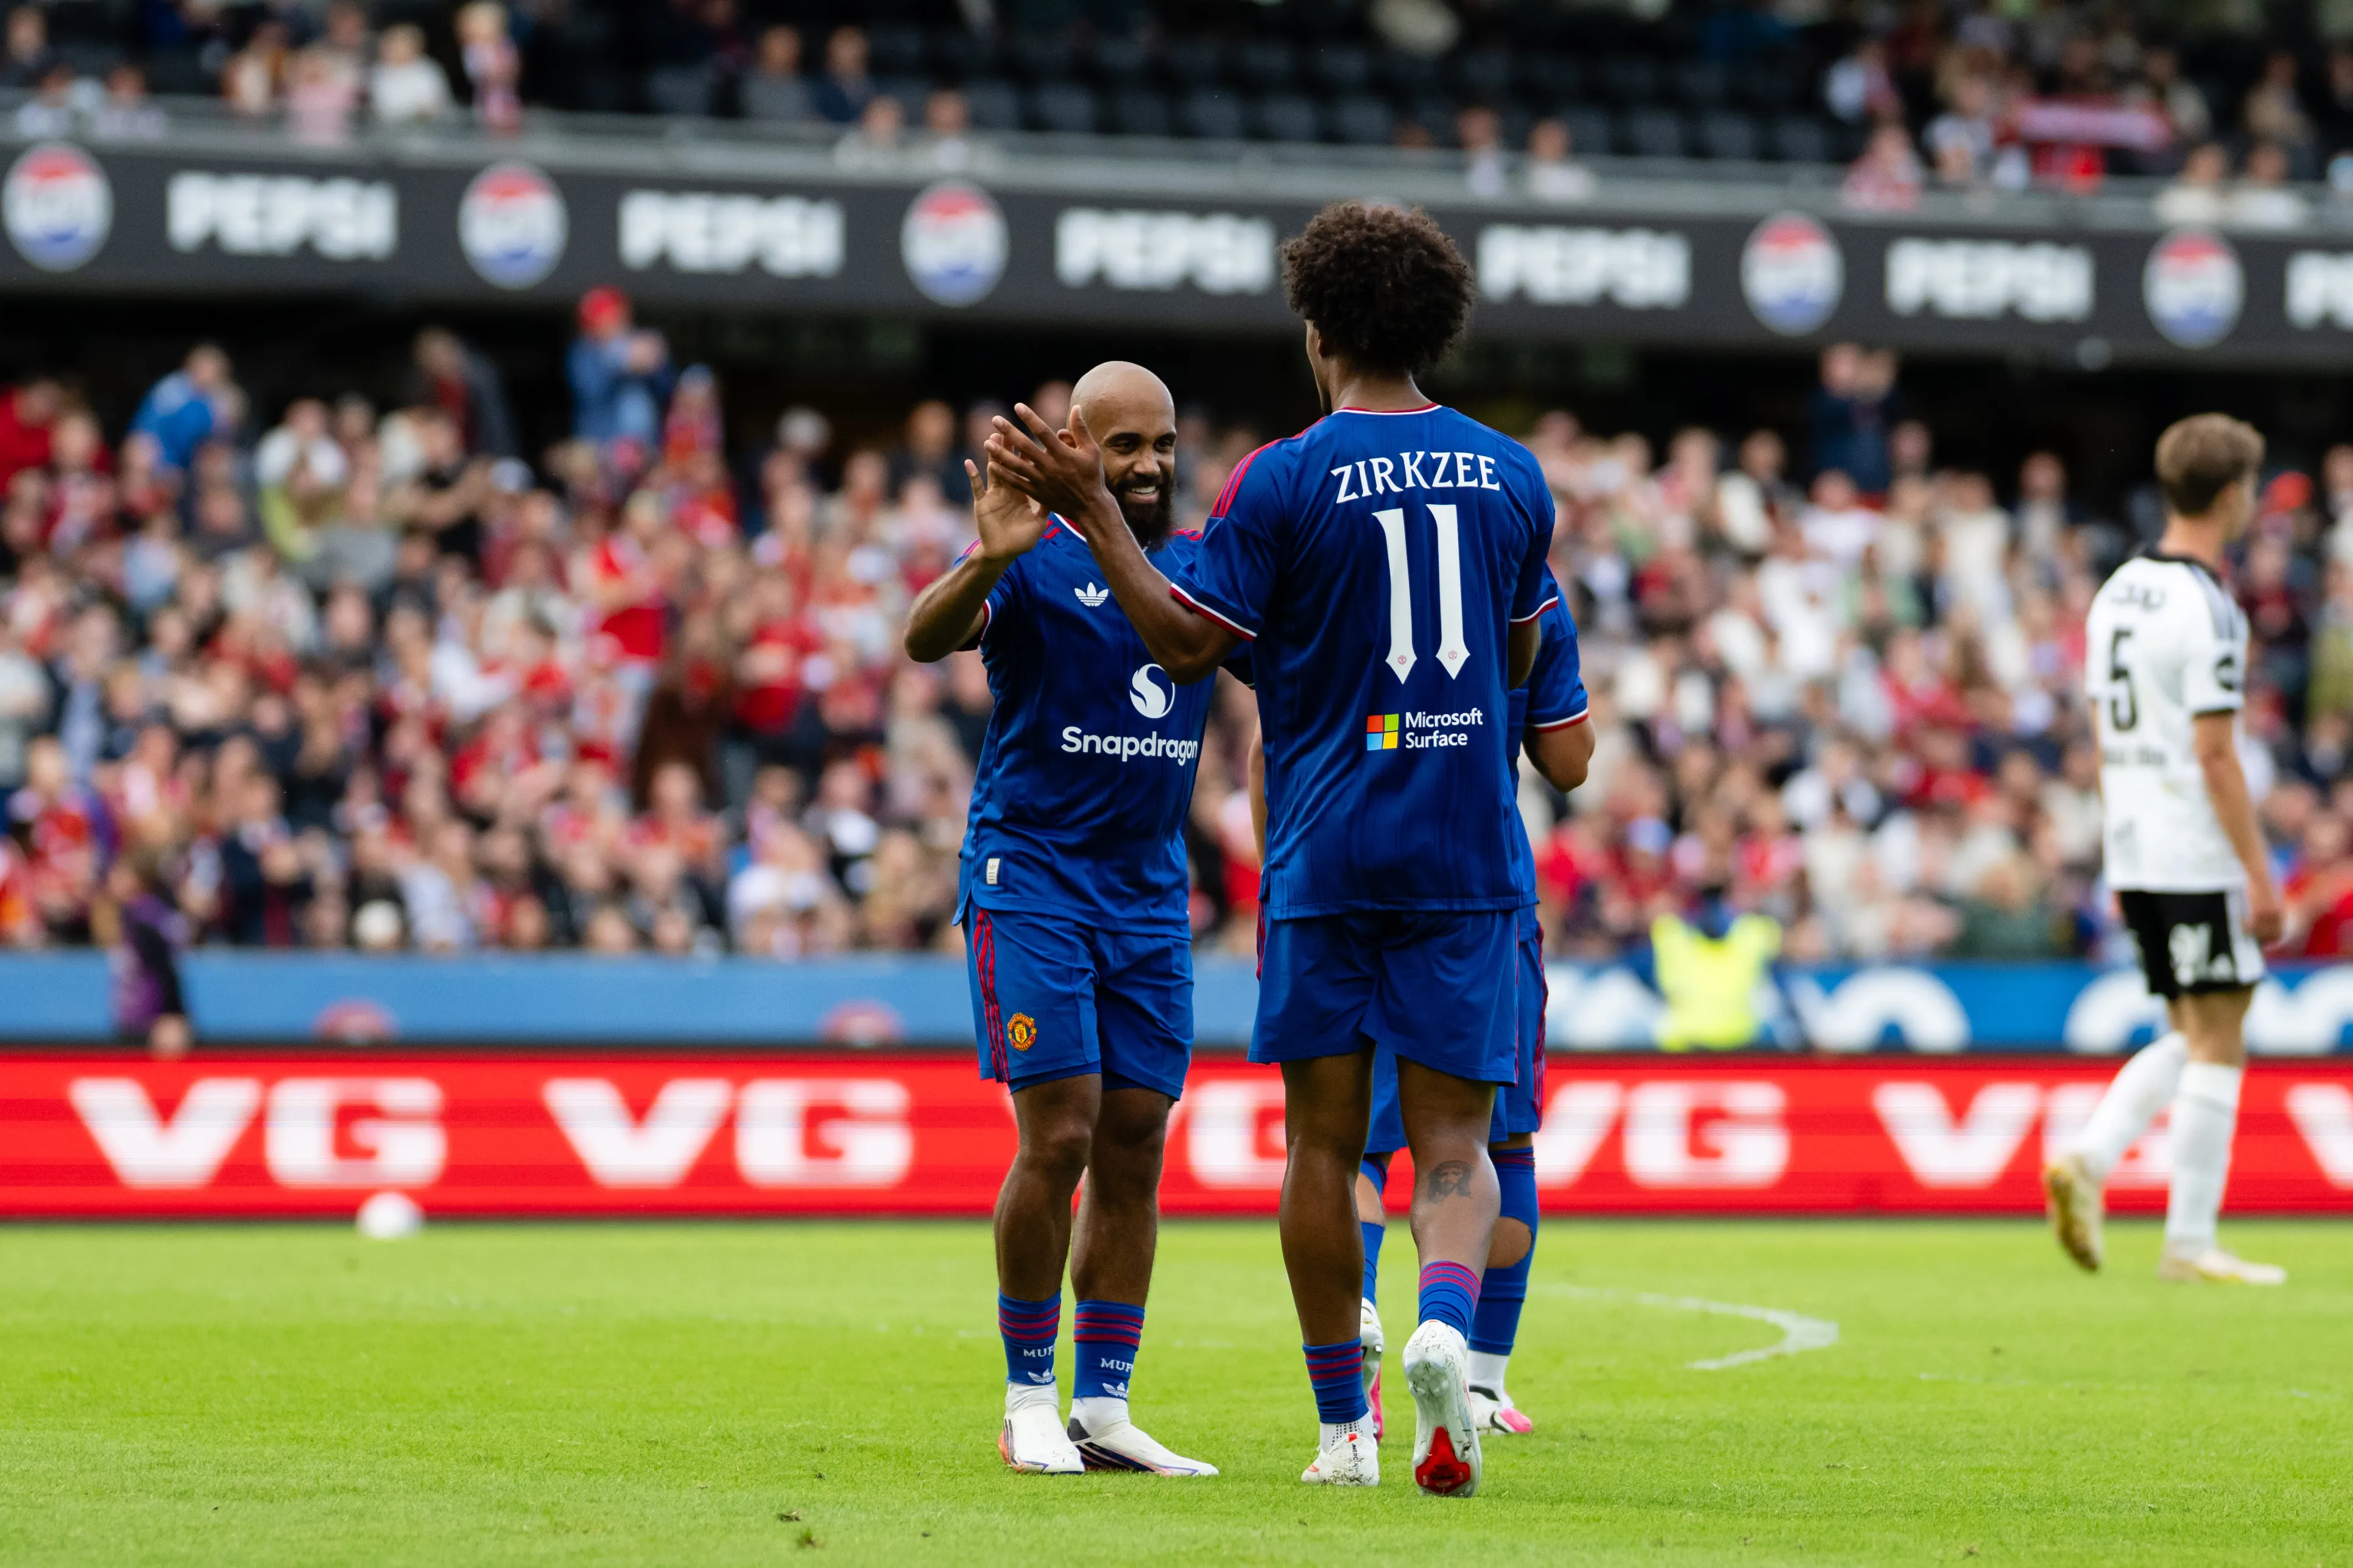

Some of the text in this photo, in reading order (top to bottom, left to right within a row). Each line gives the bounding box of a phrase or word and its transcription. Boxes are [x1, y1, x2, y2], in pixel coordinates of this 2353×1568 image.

[166, 171, 397, 260] PEPSI
[619, 188, 845, 279] PEPSI
[1055, 207, 1277, 295] PEPSI
[1476, 223, 1692, 310] PEPSI
[1884, 237, 2095, 322] PEPSI
[1331, 451, 1500, 504] ZIRKZEE
[1371, 504, 1470, 684] 11
[1405, 708, 1483, 728] Microsoft
[2109, 627, 2139, 733] 5
[1061, 726, 1198, 766] Snapdragon
[1405, 730, 1468, 748] Surface
[68, 1077, 448, 1189] VG
[541, 1077, 914, 1189] VG
